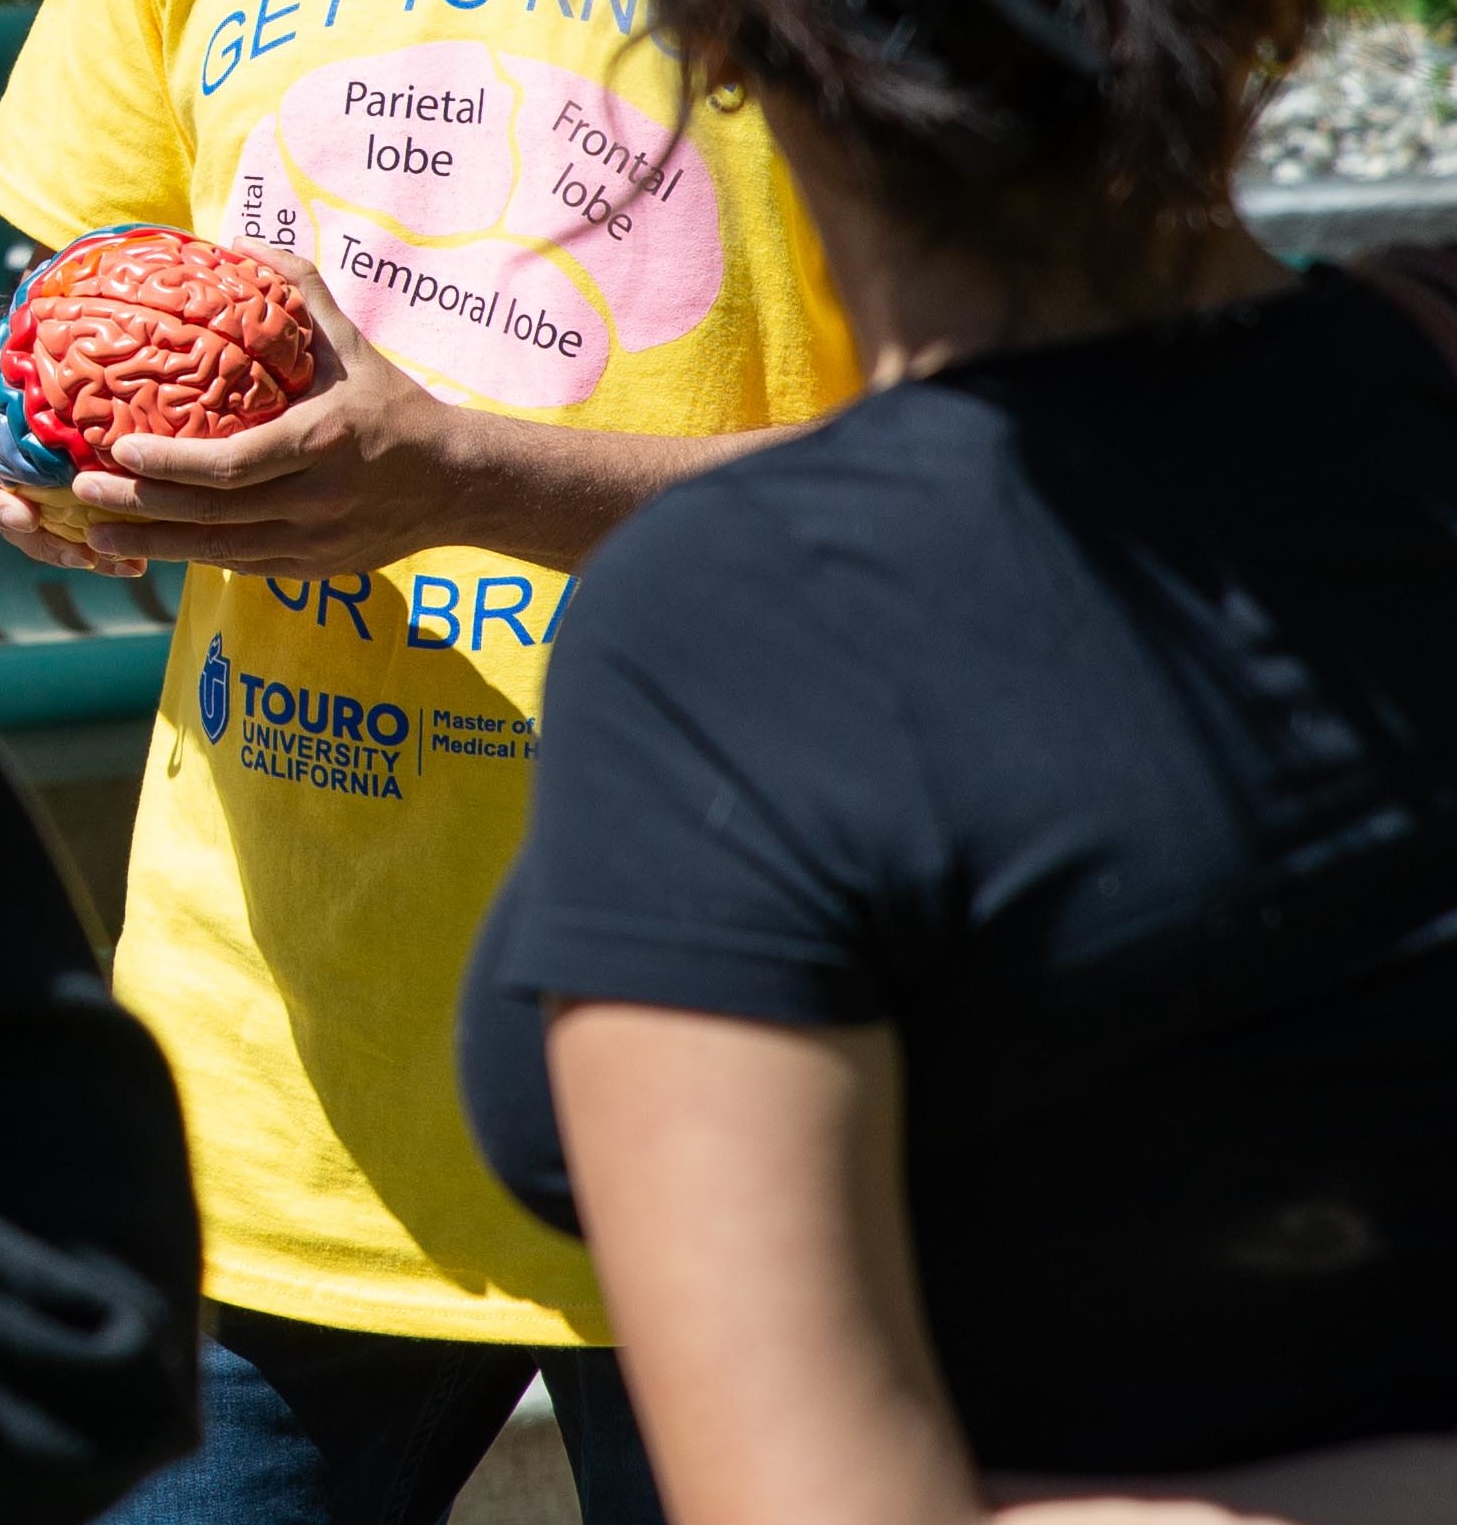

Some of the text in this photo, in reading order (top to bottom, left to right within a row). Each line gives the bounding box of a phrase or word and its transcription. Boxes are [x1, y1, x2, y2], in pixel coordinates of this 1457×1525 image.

[345, 81, 484, 125] Parietal
[366, 134, 453, 177] lobe
[552, 99, 684, 203] Frontal
[550, 162, 633, 241] lobe
[269, 208, 296, 254] be
[339, 234, 584, 358] Temporal lobe
[239, 673, 409, 746] TOURO
[434, 710, 535, 735] Master of
[241, 743, 403, 800] CALIFORNIA
[242, 720, 402, 773] UNIVERSITY
[432, 734, 515, 758] Medical
